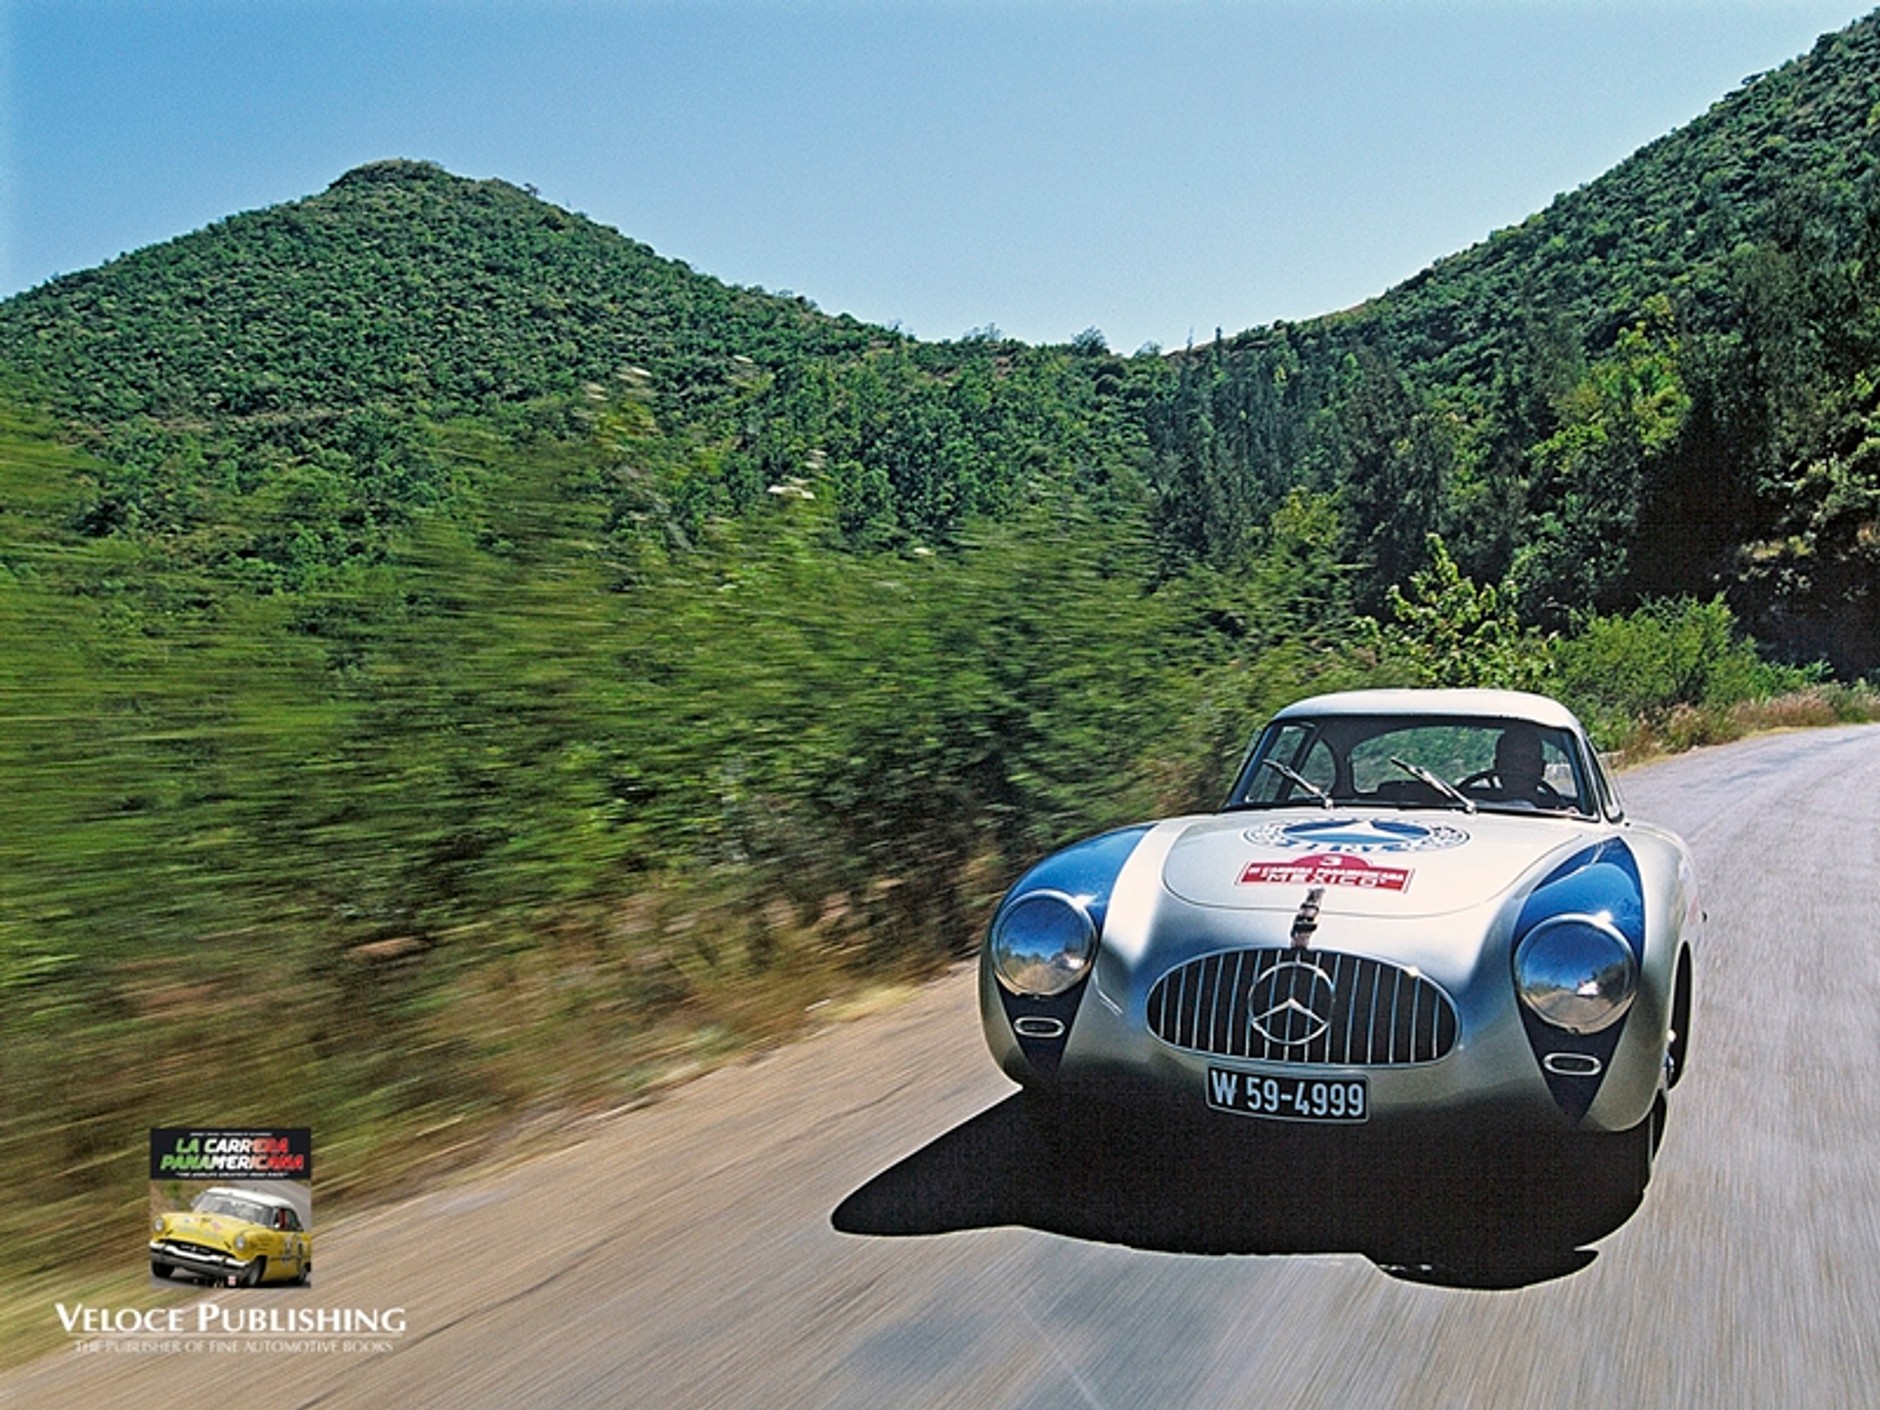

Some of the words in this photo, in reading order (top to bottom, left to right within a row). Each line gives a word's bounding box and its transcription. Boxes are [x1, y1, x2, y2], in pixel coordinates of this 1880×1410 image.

[1319, 856, 1343, 867] 3
[1266, 874, 1378, 888] MEXICO
[1211, 1069, 1238, 1106] W
[1245, 1076, 1364, 1117] 59-4999
